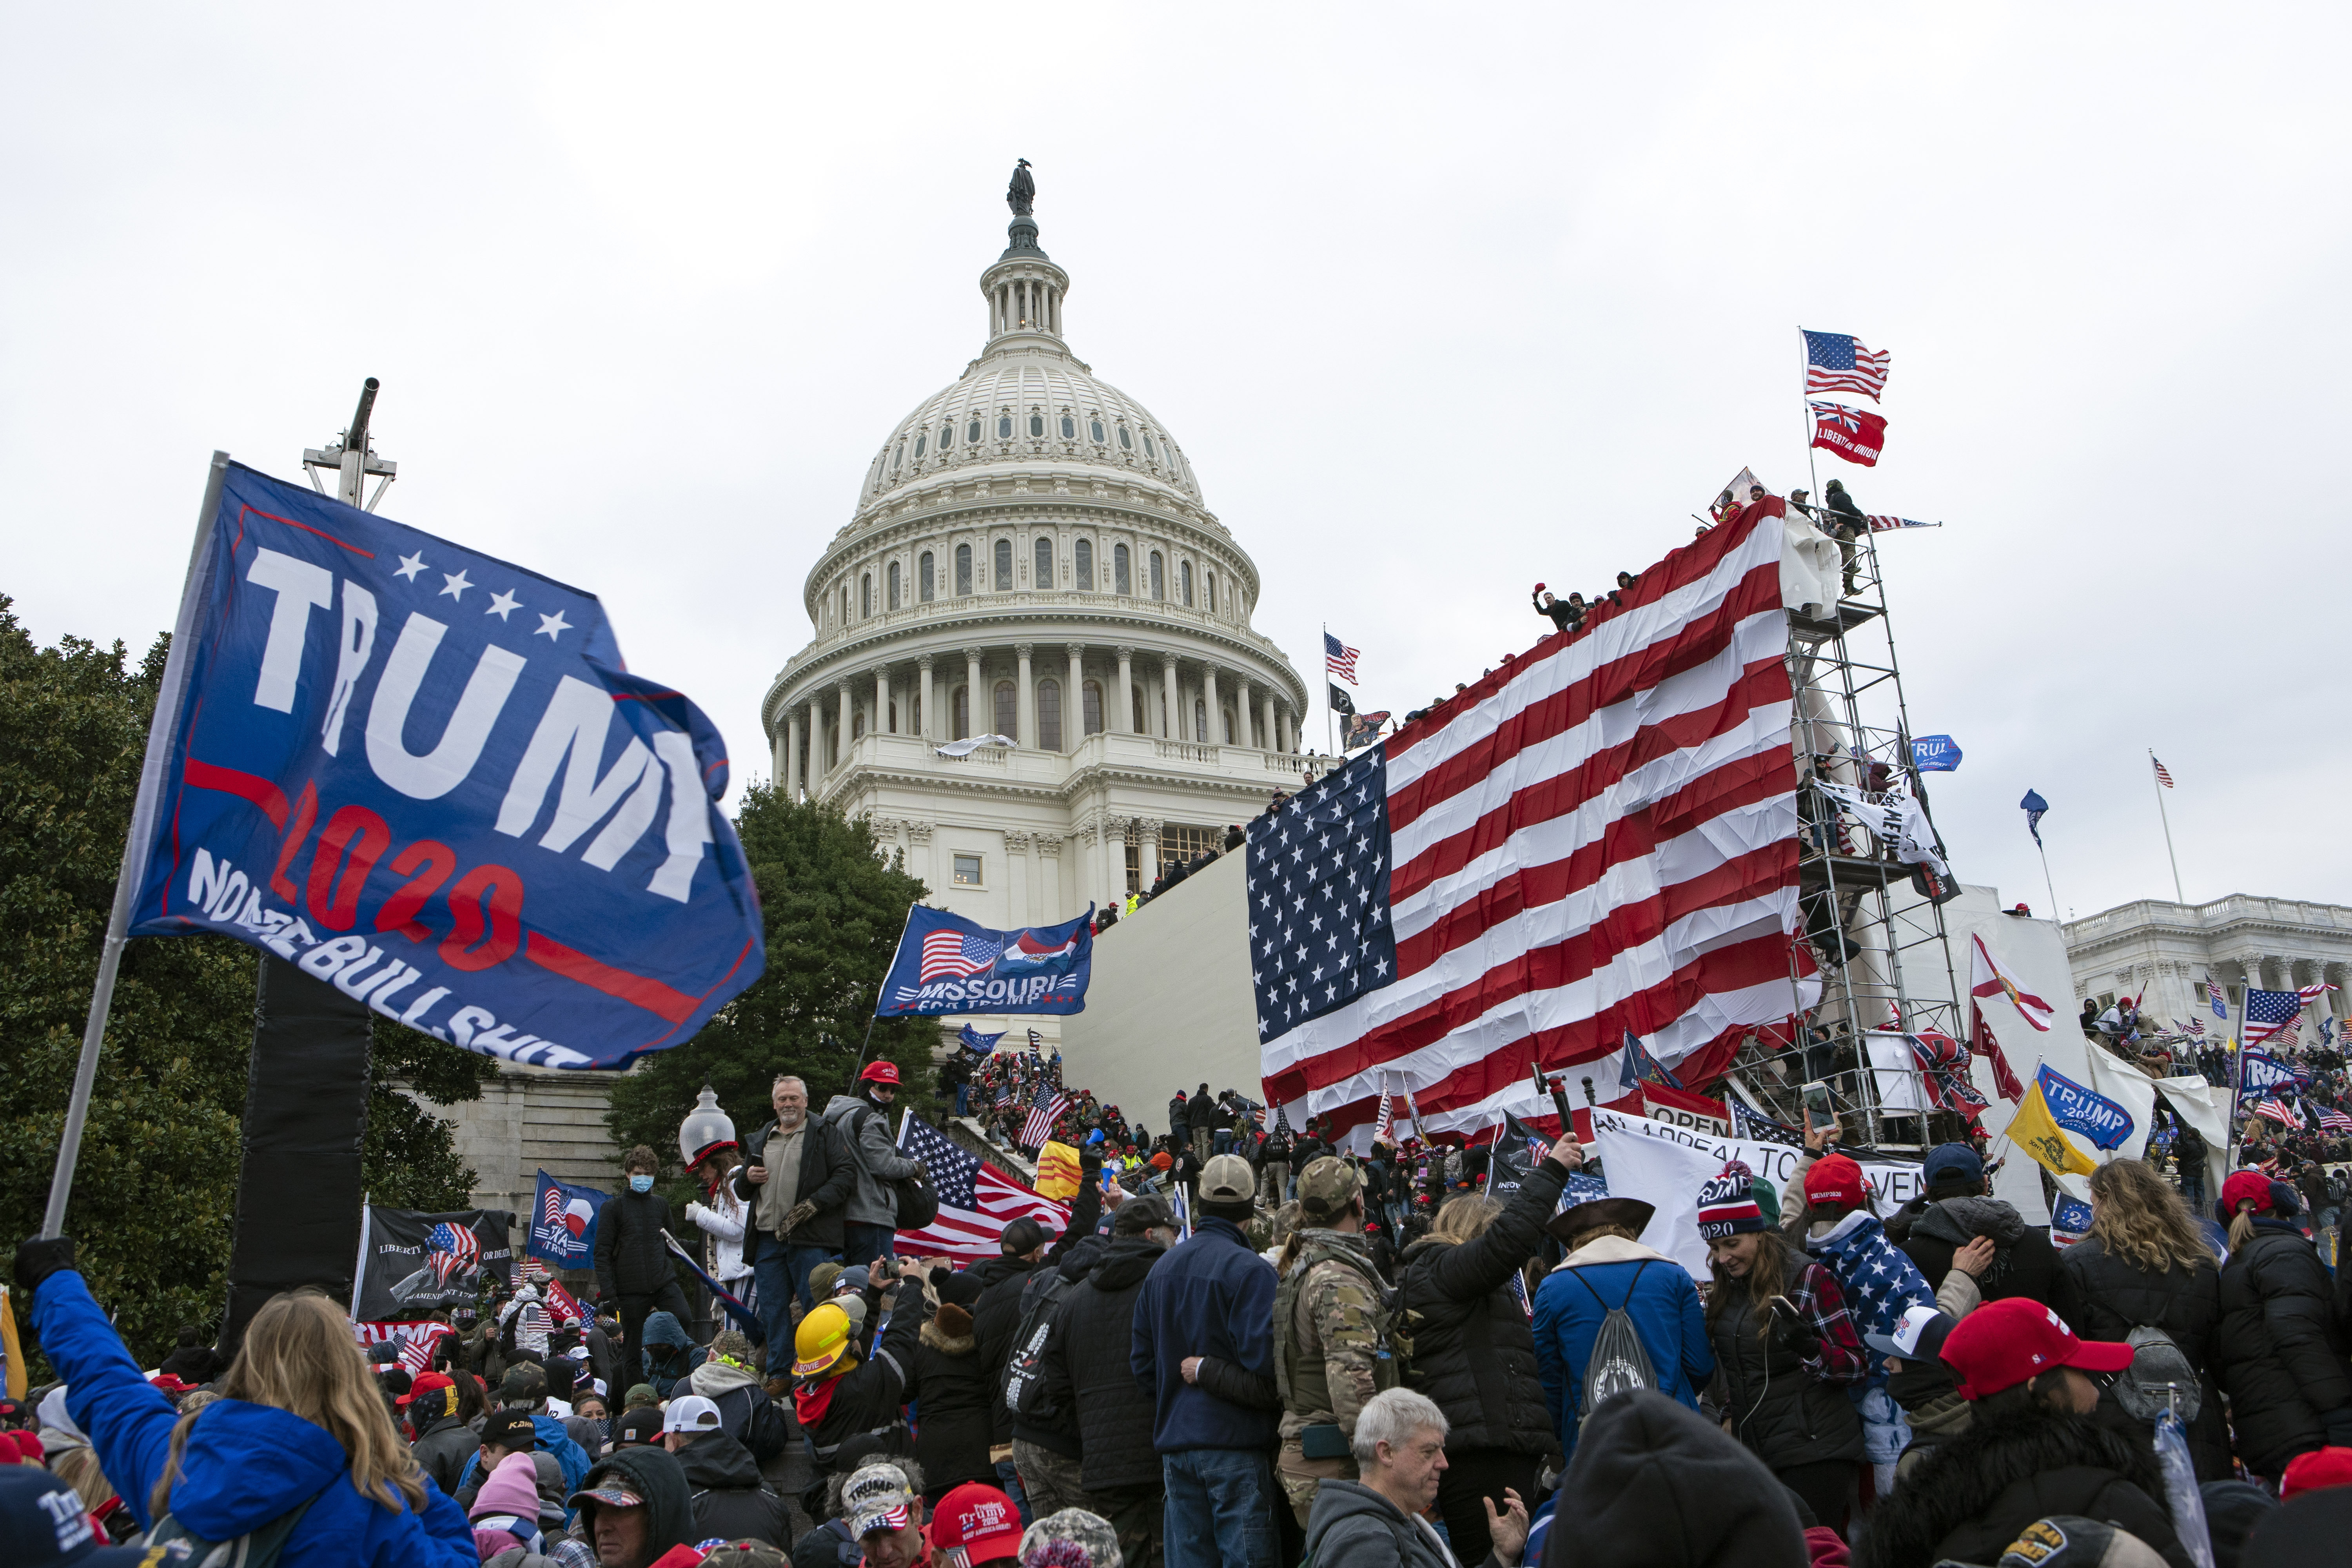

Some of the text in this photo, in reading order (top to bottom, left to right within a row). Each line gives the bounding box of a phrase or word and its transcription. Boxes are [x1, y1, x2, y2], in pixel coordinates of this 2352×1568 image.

[1818, 428, 1879, 460] LIBERTY AND UNION
[269, 778, 524, 972] 2020
[1934, 875, 1947, 894] FOR
[916, 975, 1058, 1000] MISSOURI
[2049, 1079, 2125, 1130] TRUMP
[1654, 1108, 1729, 1138] OPEN
[1759, 1147, 1798, 1183] TO
[379, 1244, 510, 1260] LIBERTY OR DEATH
[799, 1360, 820, 1372] SOVIE
[848, 1479, 895, 1502] TRUMP
[958, 1508, 1006, 1525] Trump
[974, 1501, 1004, 1512] President
[982, 1516, 999, 1526] 2020
